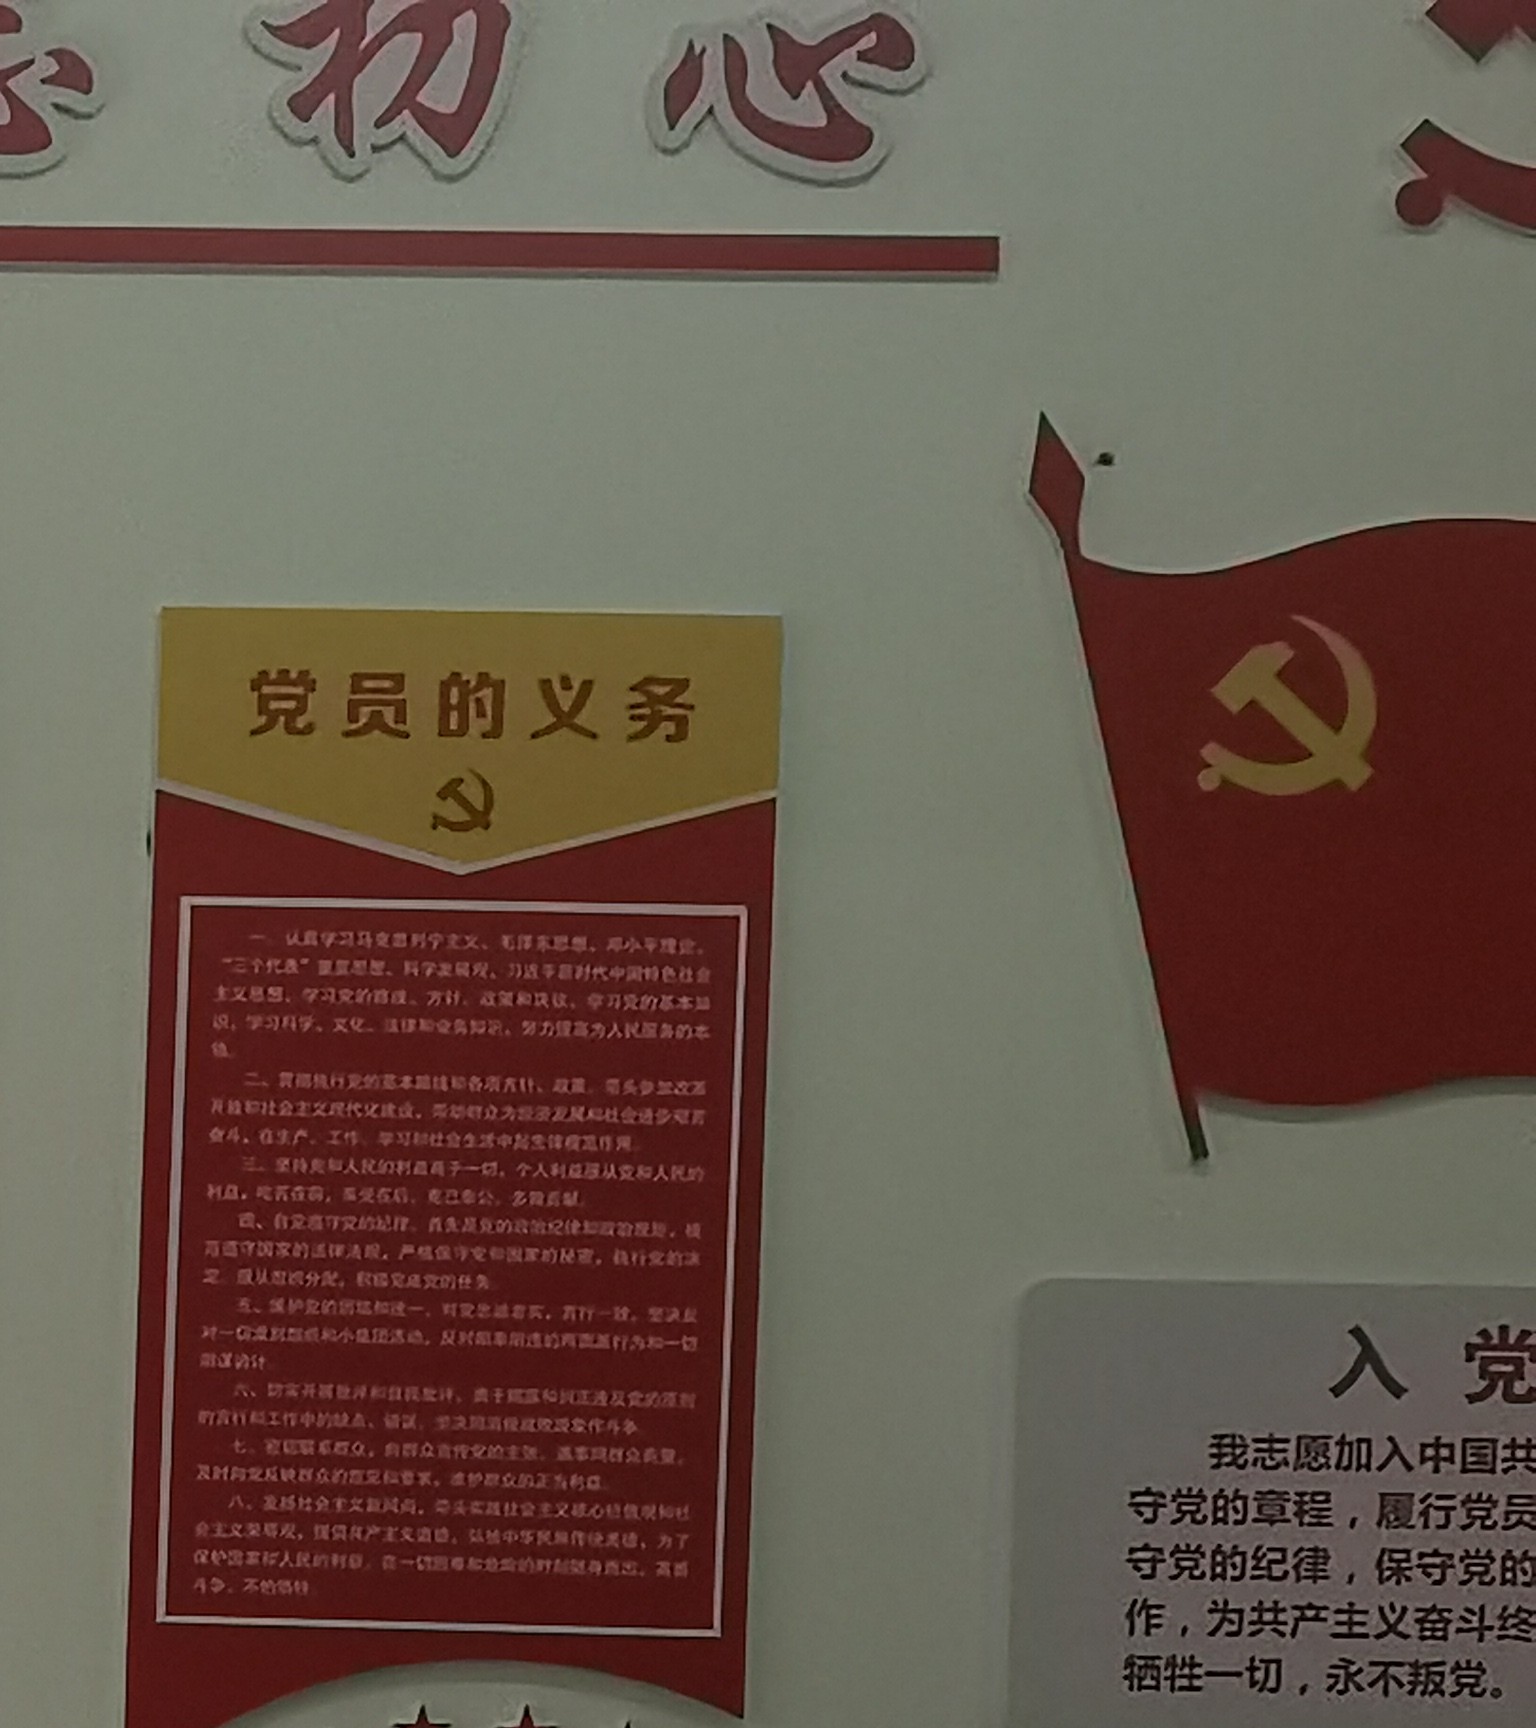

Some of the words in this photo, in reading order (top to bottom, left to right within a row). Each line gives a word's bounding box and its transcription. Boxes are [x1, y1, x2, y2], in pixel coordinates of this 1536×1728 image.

[248, 667, 696, 744] 党员的义务
[1329, 1324, 1536, 1404] 入党
[1208, 1433, 1536, 1474] 我志愿加入中国共
[1127, 1487, 1536, 1531] 守党的章程，履行党员
[1126, 1545, 1536, 1588] 守党的纪律，保守党的
[1125, 1599, 1536, 1644] 作，为共产主义奋斗终
[1122, 1654, 1503, 1699] 牺牲一切，永不叛党。
